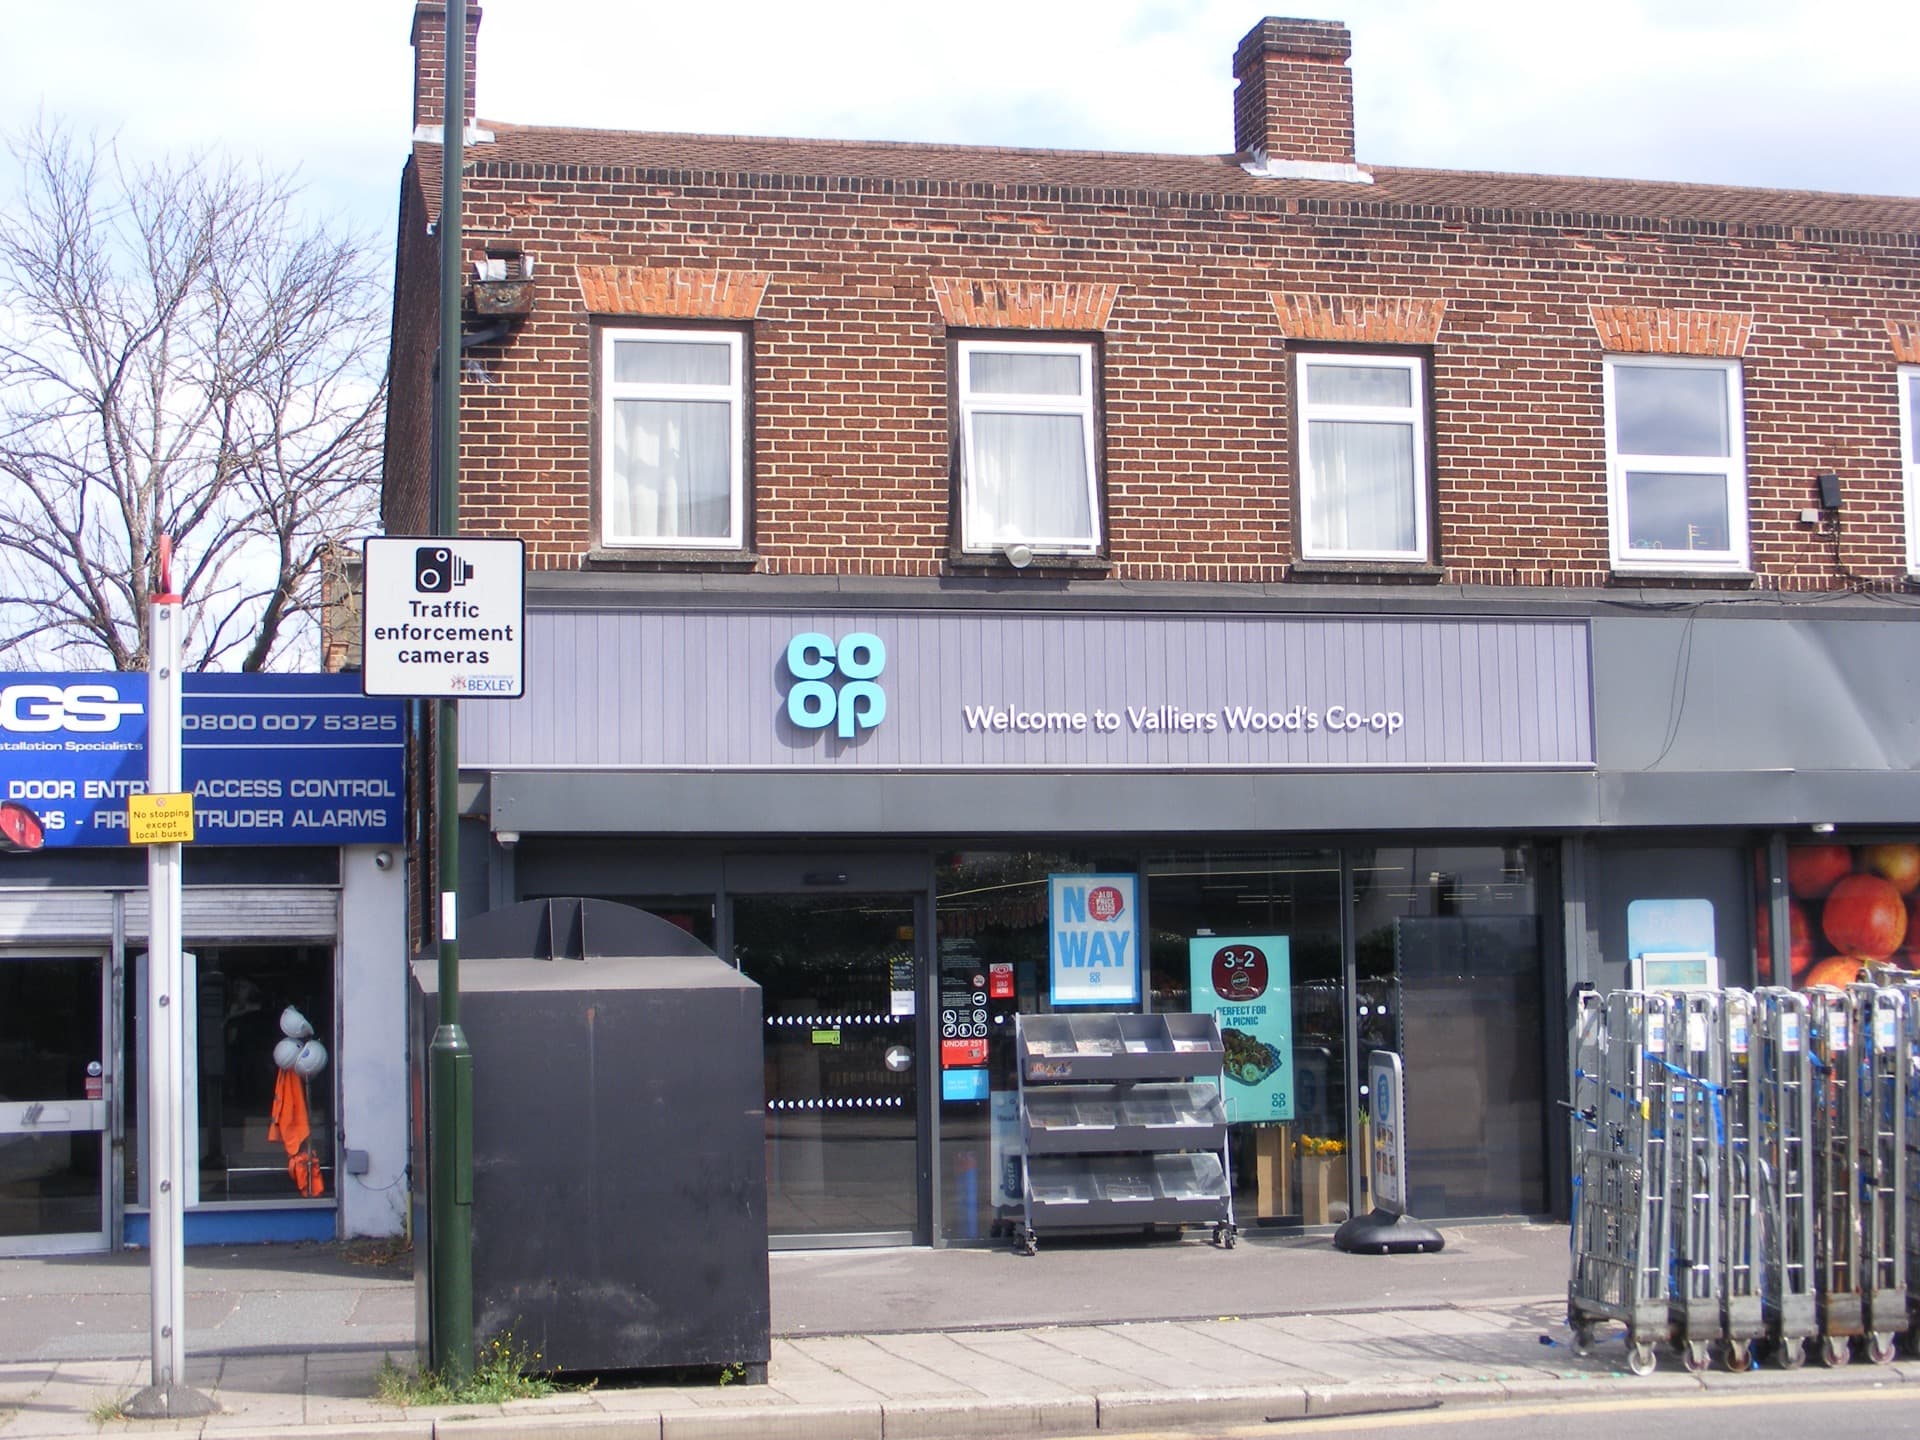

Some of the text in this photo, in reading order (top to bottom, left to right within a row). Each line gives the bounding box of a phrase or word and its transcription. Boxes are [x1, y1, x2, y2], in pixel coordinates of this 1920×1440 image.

[409, 600, 479, 618] Traffic
[374, 623, 513, 641] enforcement
[398, 650, 490, 664] cameras
[468, 679, 514, 691] BEXLEY
[0, 684, 144, 732] GS
[181, 714, 397, 730] 0800 007 5325
[965, 704, 1404, 735] Welcome to Valliers Wood's Co-op
[65, 741, 143, 752] Specialists
[9, 780, 76, 799] DOOR
[193, 779, 282, 797] ACCESS
[290, 779, 396, 797] CONTROL
[94, 811, 129, 829] FIR
[292, 809, 387, 827] ALARMS
[133, 810, 190, 819] No stopping
[145, 820, 177, 829] except
[136, 831, 158, 840] local
[1057, 931, 1130, 967] WAY
[1224, 951, 1235, 968] 3
[1244, 951, 1255, 967] 2
[1251, 1005, 1266, 1014] FOR
[1226, 1017, 1259, 1026] A PICNIC
[943, 1040, 968, 1048] UNDER
